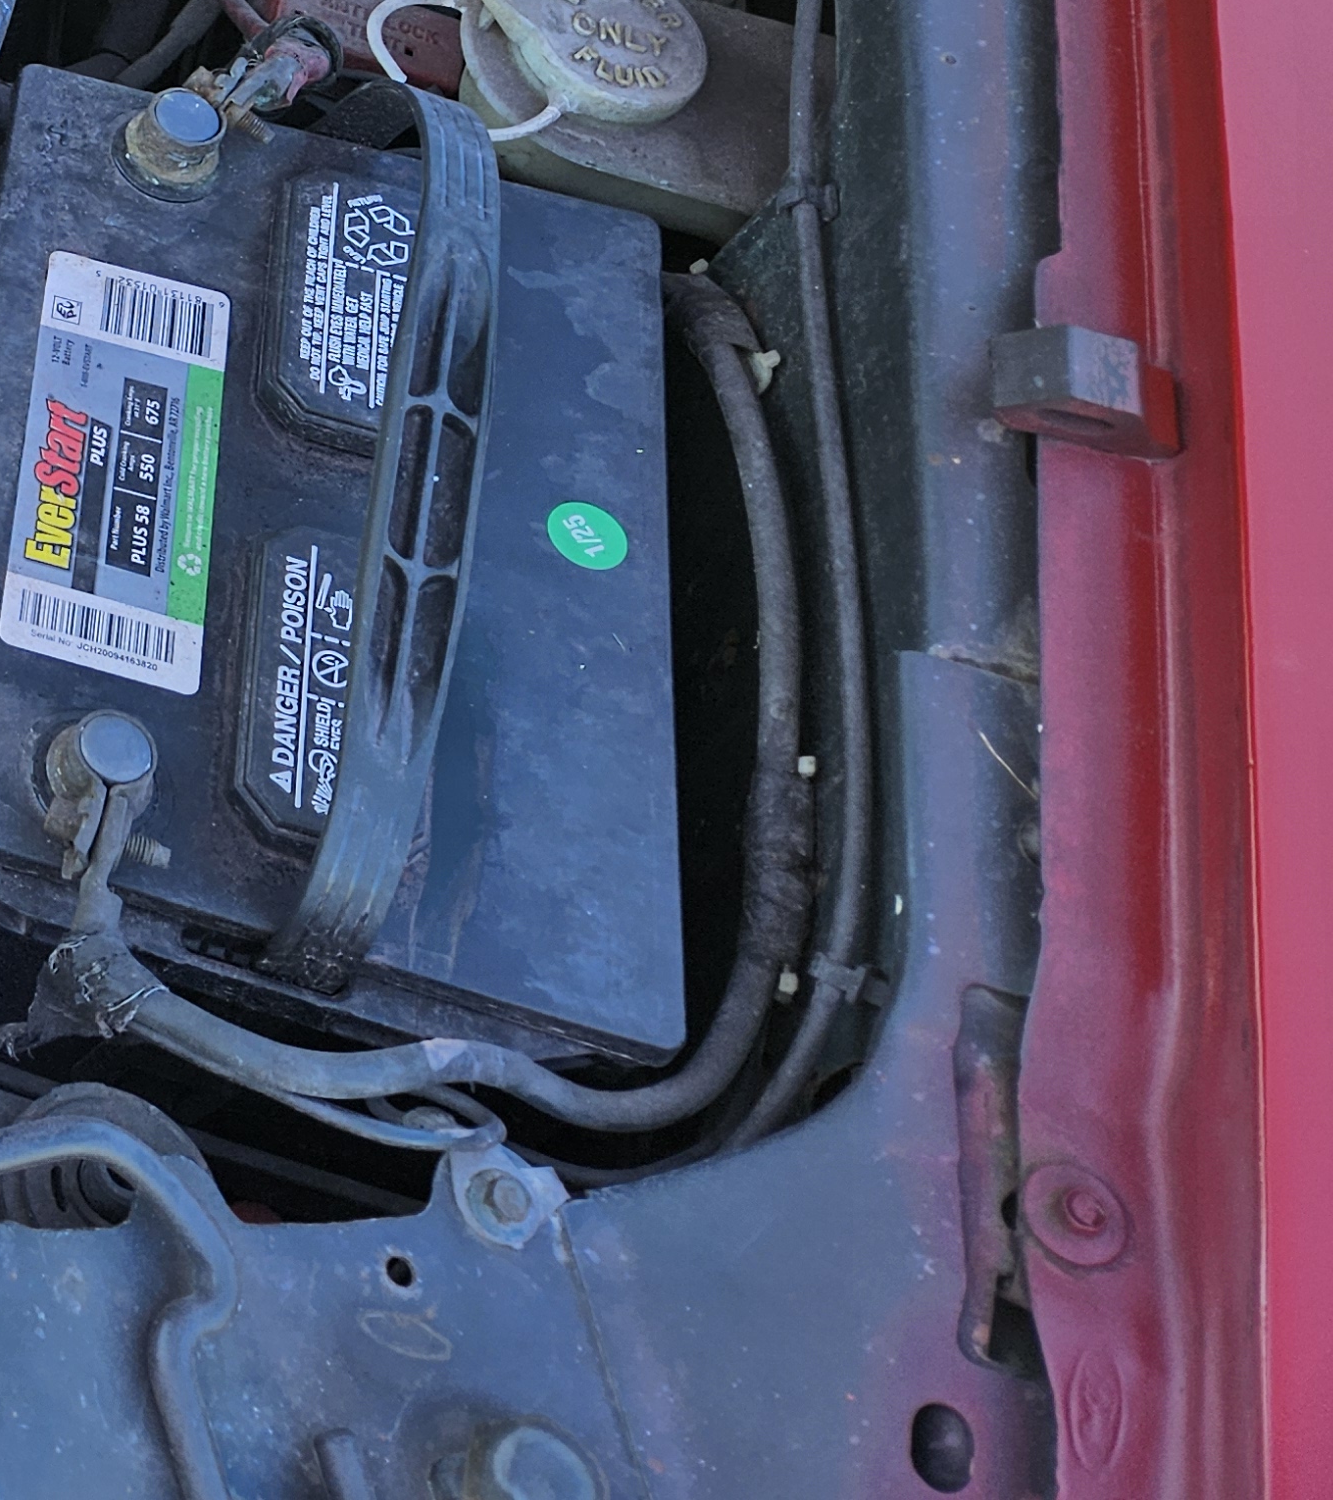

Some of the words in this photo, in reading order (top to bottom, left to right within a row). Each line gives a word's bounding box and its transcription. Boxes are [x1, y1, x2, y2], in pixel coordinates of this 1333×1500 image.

[571, 11, 669, 57] ONLY
[571, 45, 667, 88] FLUID
[321, 194, 331, 217] LEVEL
[308, 206, 320, 244] CHILDREN
[320, 218, 330, 235] AND
[307, 245, 317, 257] OF
[318, 236, 328, 259] TIGHT
[305, 259, 316, 286] REACH
[316, 261, 327, 282] CAPS
[162, 287, 203, 303] 81131
[303, 287, 314, 302] THE
[315, 284, 325, 305] VENT
[331, 263, 347, 314] IMMEDIATELY
[380, 278, 392, 313] STARTING
[302, 305, 313, 317] OF
[345, 295, 358, 313] GET
[359, 290, 373, 312] FAST
[301, 318, 312, 336] OUT
[313, 307, 324, 328] KEEP
[329, 314, 343, 335] EYES
[343, 315, 357, 342] WATER
[358, 313, 372, 334] HELP
[378, 313, 390, 334] JUMP
[51, 335, 62, 363] 12-VOLT
[61, 338, 75, 366] Battery
[299, 337, 311, 359] KEEP
[311, 347, 321, 365] NOT
[327, 335, 341, 363] FLUSH
[341, 343, 355, 365] WITH
[356, 335, 371, 369] MEDICAL
[377, 335, 388, 354] SAFE
[309, 366, 320, 380] DO
[376, 355, 387, 371] FOR
[126, 385, 135, 401] Amps
[123, 401, 134, 426] Cranking
[144, 399, 160, 425] 675
[169, 416, 178, 427] AR
[89, 424, 108, 466] PLUS
[120, 440, 130, 466] Cranking
[118, 467, 126, 481] Cold
[127, 454, 135, 471] Amps
[139, 452, 155, 482] 550
[24, 398, 88, 570] EverStart
[184, 474, 197, 512] WALMART
[134, 504, 150, 524] 58
[160, 487, 172, 519] Walmart
[111, 505, 122, 532] Number
[159, 519, 171, 529] by
[109, 532, 119, 549] Part
[130, 525, 148, 565] PLUS
[563, 511, 607, 561] 1/25
[154, 529, 168, 572] Distributed
[280, 555, 309, 644] POISON
[29, 628, 56, 642] Serial
[279, 643, 301, 667] /
[271, 664, 302, 769] DANGER
[314, 701, 330, 747] SHIELD
